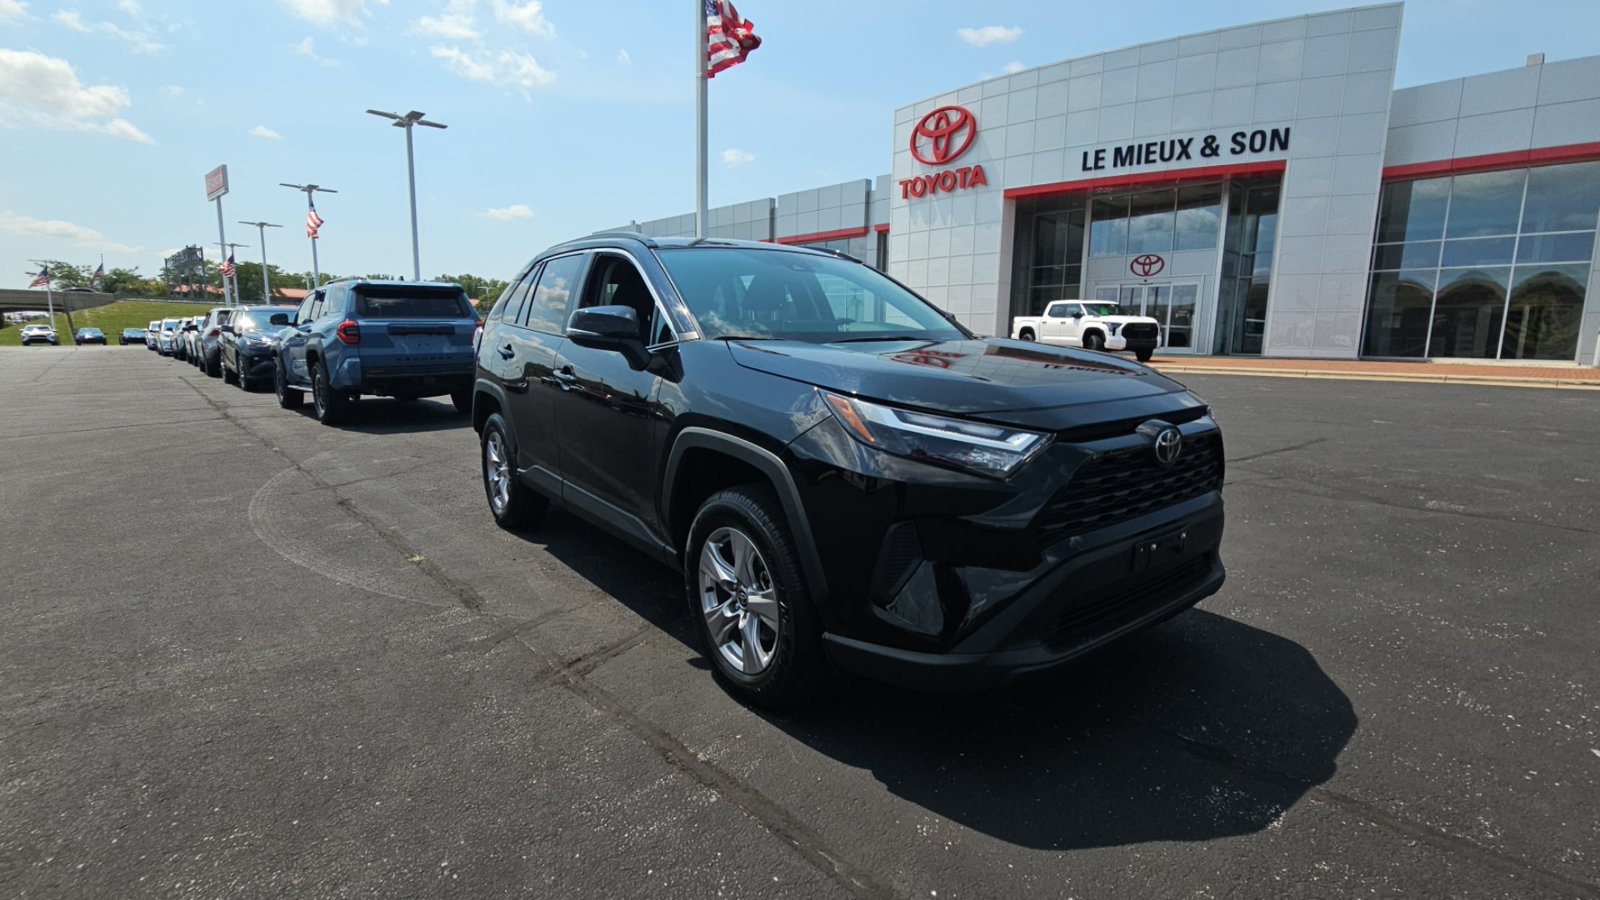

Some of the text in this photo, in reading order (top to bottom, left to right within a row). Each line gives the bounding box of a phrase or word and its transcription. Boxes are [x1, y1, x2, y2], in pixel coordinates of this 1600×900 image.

[1082, 127, 1290, 172] LE MIEUX & SON
[899, 165, 987, 199] TOYOTA
